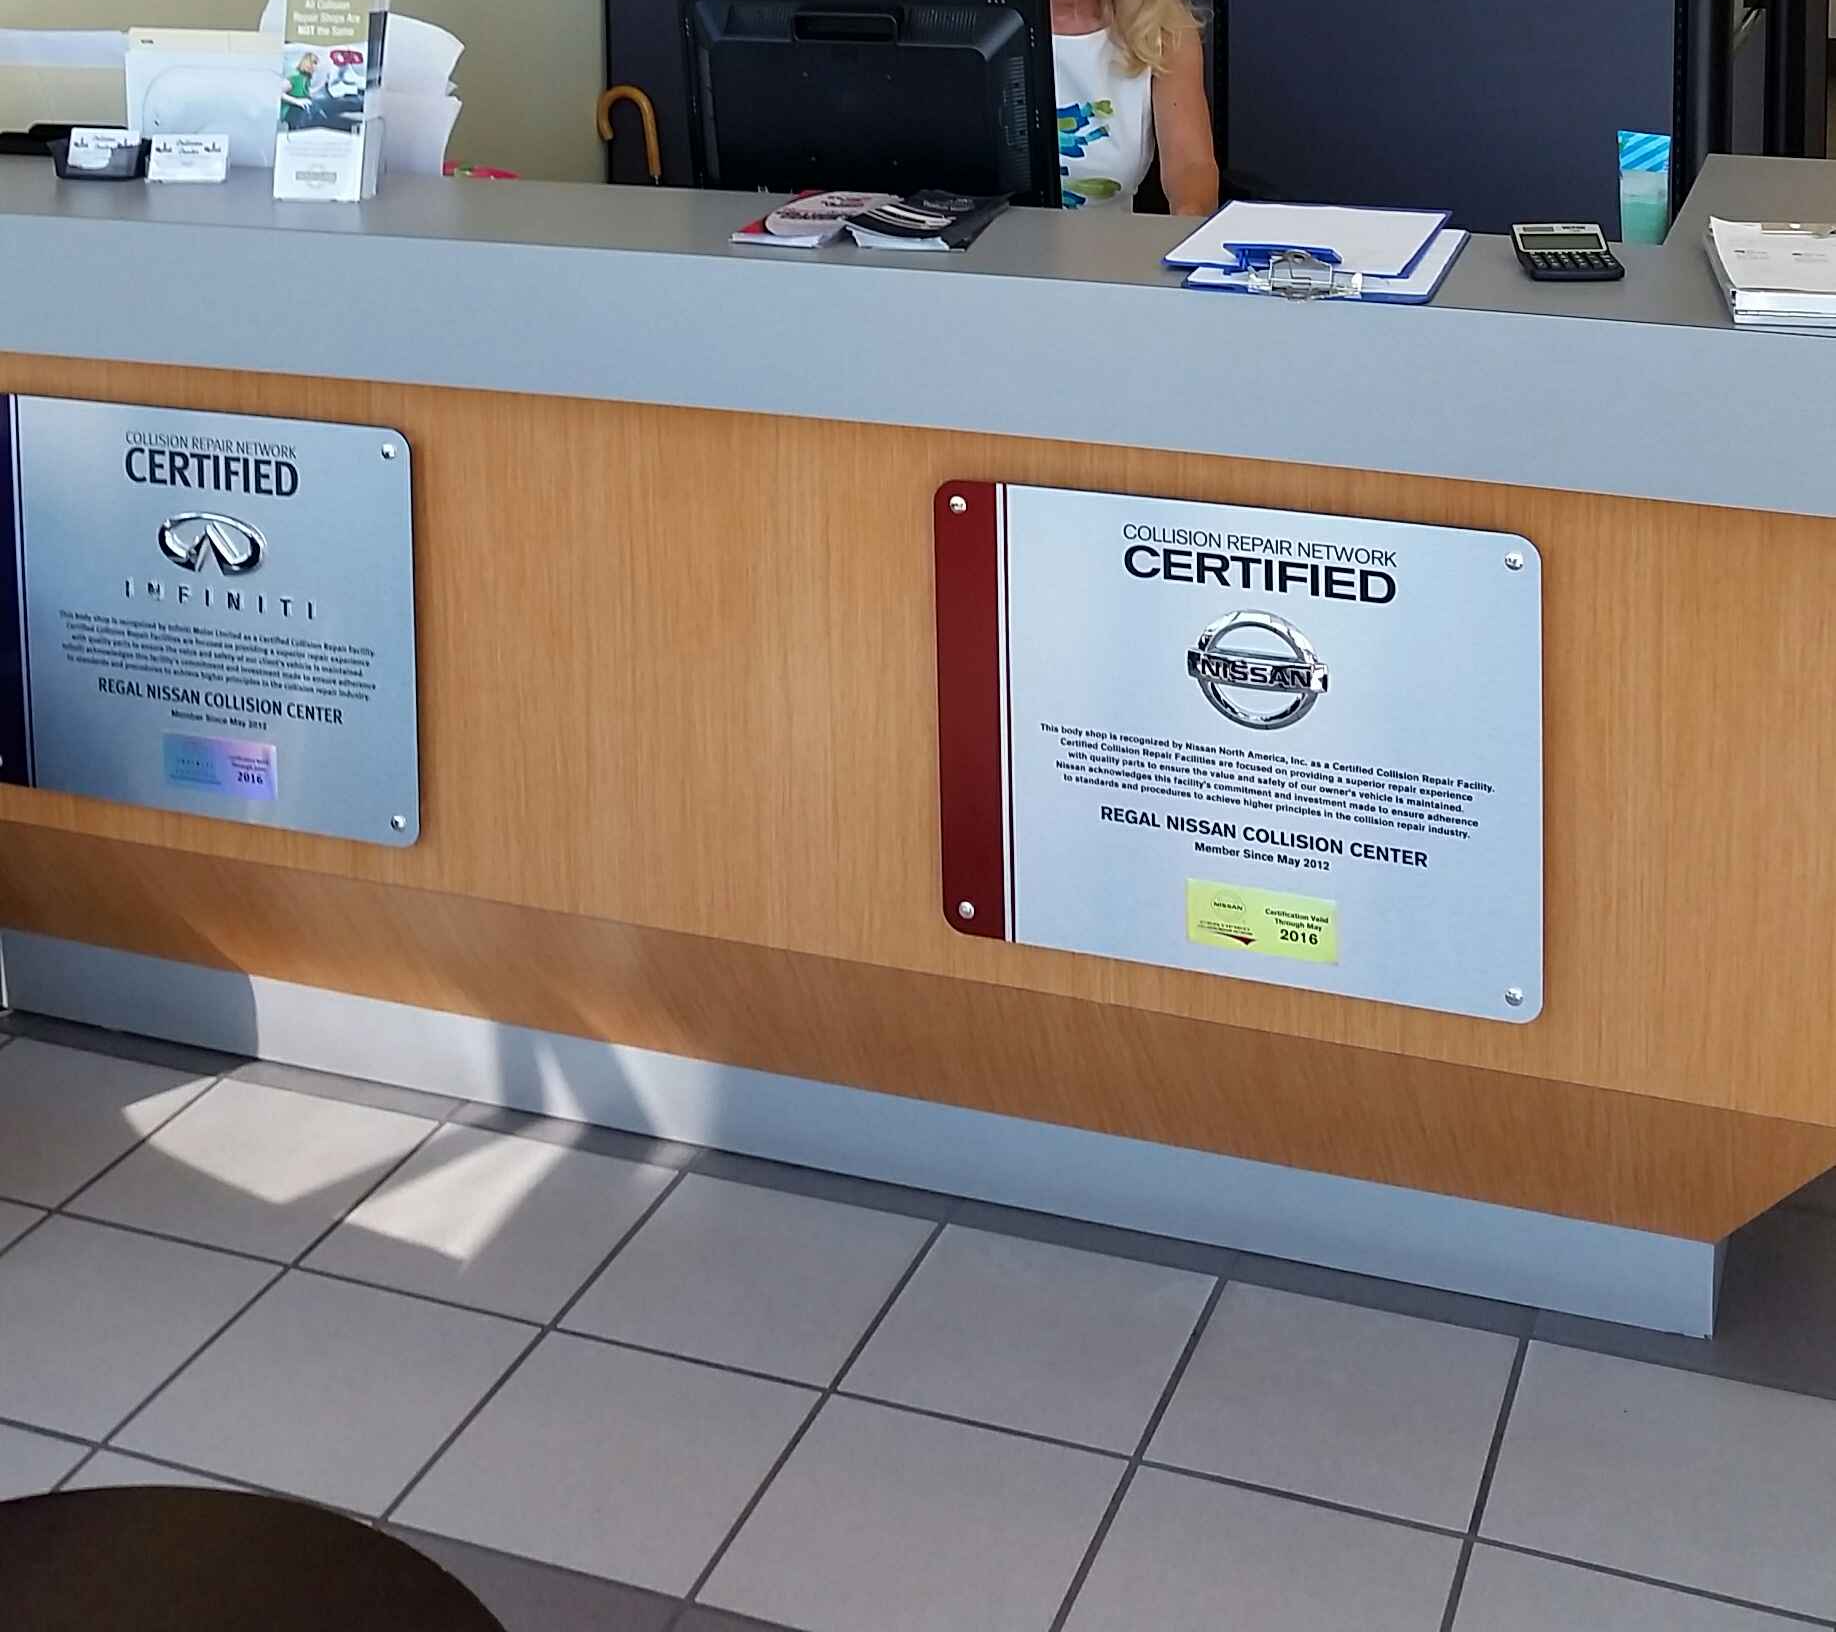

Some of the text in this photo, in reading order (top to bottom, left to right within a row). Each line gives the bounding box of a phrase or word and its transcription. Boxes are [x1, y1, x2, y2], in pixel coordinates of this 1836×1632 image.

[125, 431, 297, 459] COLLISION REPAIR NETWORK
[125, 447, 298, 497] CERTIFIED
[1123, 523, 1397, 568] COLLISION REPAIR NETWORK
[1124, 544, 1397, 604] CERTIFIED
[125, 579, 314, 620] INFINITI
[1201, 658, 1312, 688] NISSAN
[98, 676, 343, 724] REGAL NISSAN COLLISION CENTER
[229, 717, 246, 728] May
[1040, 723, 1058, 732] This
[1061, 726, 1082, 736] body
[1085, 730, 1107, 740] shop
[1110, 732, 1117, 740] is
[1120, 735, 1169, 747] recognized
[1172, 740, 1182, 750] by
[1185, 742, 1216, 753] Nissan
[1219, 747, 1244, 757] North
[1332, 763, 1373, 775] Certified
[1376, 769, 1419, 781] Collision
[1422, 775, 1453, 786] Repair
[1060, 737, 1098, 749] Certified
[1100, 743, 1140, 755] Collision
[1142, 748, 1171, 759] Repair
[1174, 753, 1215, 765] Facilities
[1219, 760, 1233, 768] are
[1236, 761, 1272, 773] focused
[1290, 770, 1334, 783] providing
[1346, 778, 1385, 788] superior
[1388, 784, 1416, 793] repair
[1419, 788, 1472, 801] experience
[238, 771, 263, 785] 2016
[1056, 760, 1085, 771] Nissan
[1088, 767, 1152, 780] acknowledges
[1154, 774, 1170, 783] this
[1214, 784, 1271, 797] commitment
[1274, 792, 1291, 800] and
[1294, 793, 1346, 807] investment
[1349, 803, 1375, 811] made
[1378, 806, 1388, 814] to
[1391, 809, 1424, 819] ensure
[1427, 814, 1478, 826] adherence
[1090, 755, 1119, 765] quality
[1122, 759, 1144, 767] parts
[1148, 761, 1156, 769] to
[1159, 764, 1190, 773] ensure
[1192, 767, 1207, 776] the
[1210, 771, 1234, 779] value
[1258, 777, 1285, 788] safety
[1359, 792, 1392, 802] vehicle
[1396, 795, 1403, 803] is
[1064, 773, 1072, 781] to
[1075, 776, 1118, 787] standards
[1140, 785, 1191, 797] procedures
[1194, 791, 1203, 799] to
[1206, 794, 1240, 804] achieve
[1243, 798, 1272, 809] higher
[1276, 804, 1321, 816] principles
[1324, 809, 1332, 818] in
[1336, 812, 1351, 820] the
[1354, 816, 1394, 826] collision
[1397, 822, 1425, 831] repair
[1100, 805, 1428, 868] REGAL NISSAN COLLISION CENTER
[1194, 841, 1330, 871] Member Since May 2012
[1213, 901, 1244, 911] NISSAN
[1265, 908, 1329, 924] Certification Valid
[1275, 917, 1322, 932] Through May
[1280, 928, 1318, 945] 2016
